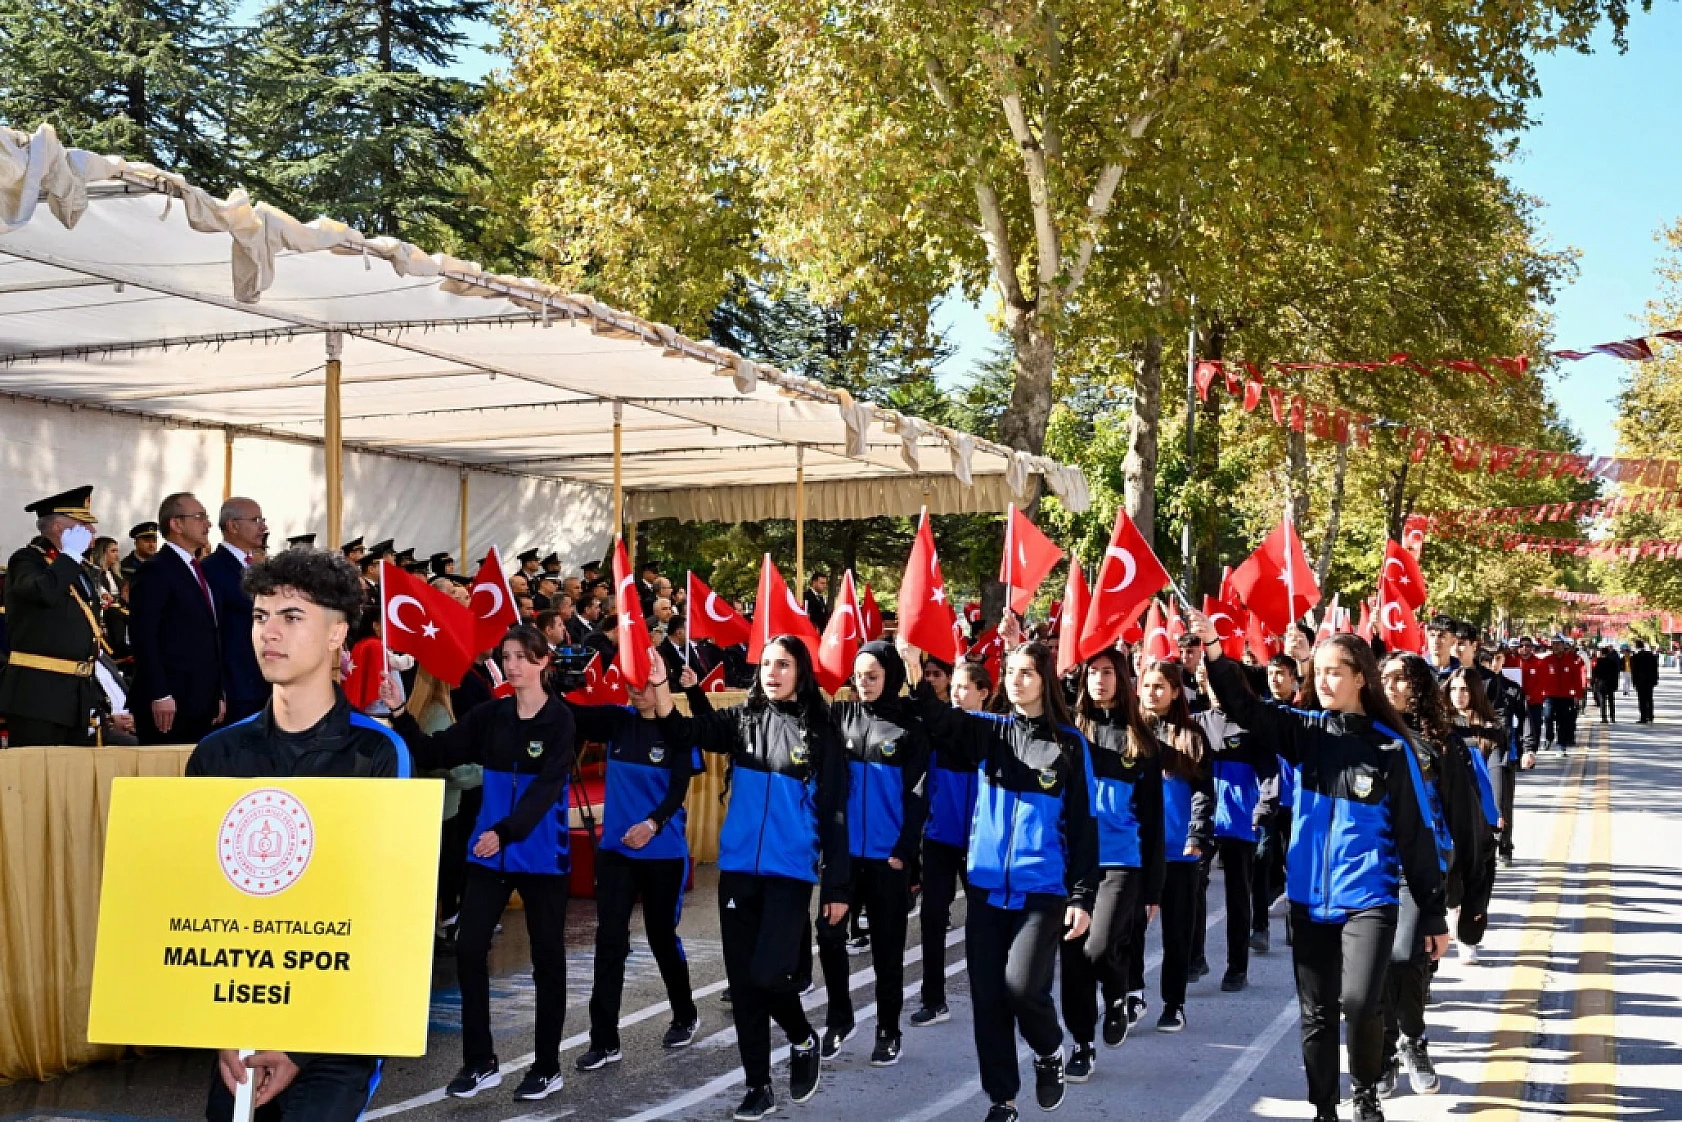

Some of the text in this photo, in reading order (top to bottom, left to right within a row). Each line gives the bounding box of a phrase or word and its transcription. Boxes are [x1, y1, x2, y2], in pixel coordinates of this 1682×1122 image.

[170, 918, 240, 932] MALATYA
[253, 919, 351, 935] BATTALGAZİ
[163, 947, 351, 971] MALATYA SPOR
[213, 979, 291, 1004] LİSESİ
